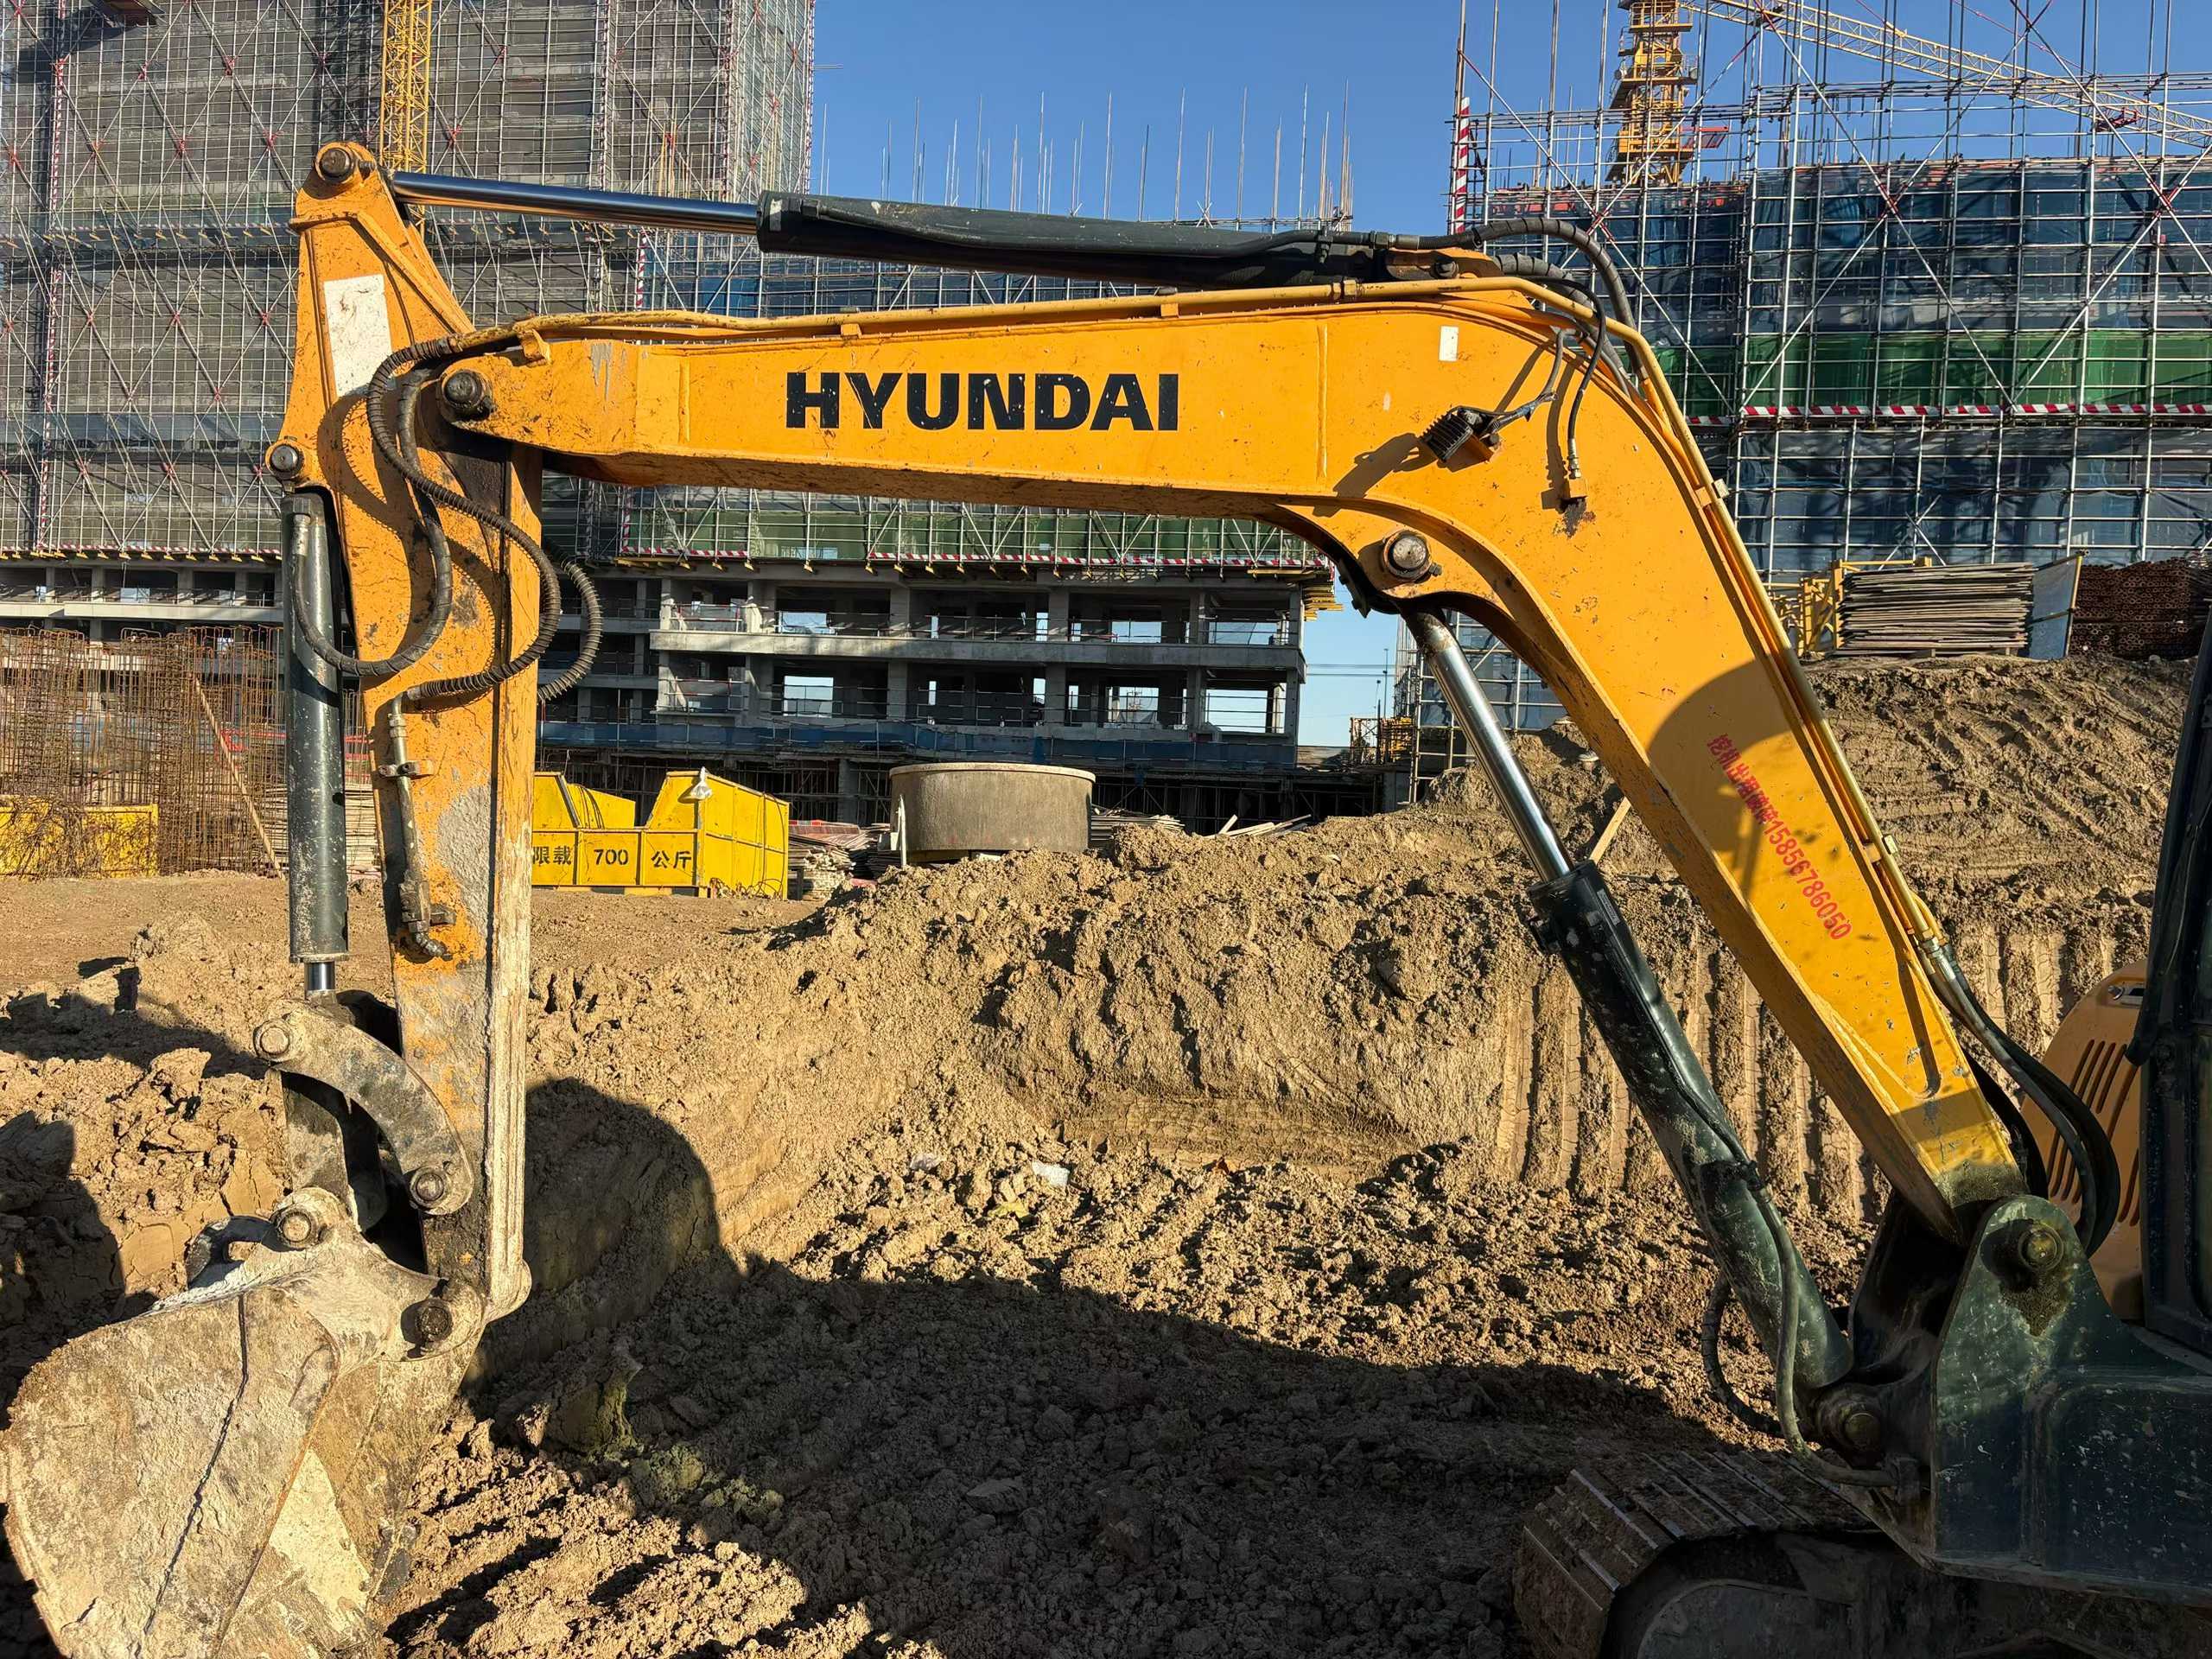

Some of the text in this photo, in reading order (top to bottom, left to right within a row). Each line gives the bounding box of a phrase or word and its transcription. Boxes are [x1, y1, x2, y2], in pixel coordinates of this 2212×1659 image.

[785, 372, 1179, 431] HYUNDAI
[532, 845, 691, 868] 限载 700 公斤
